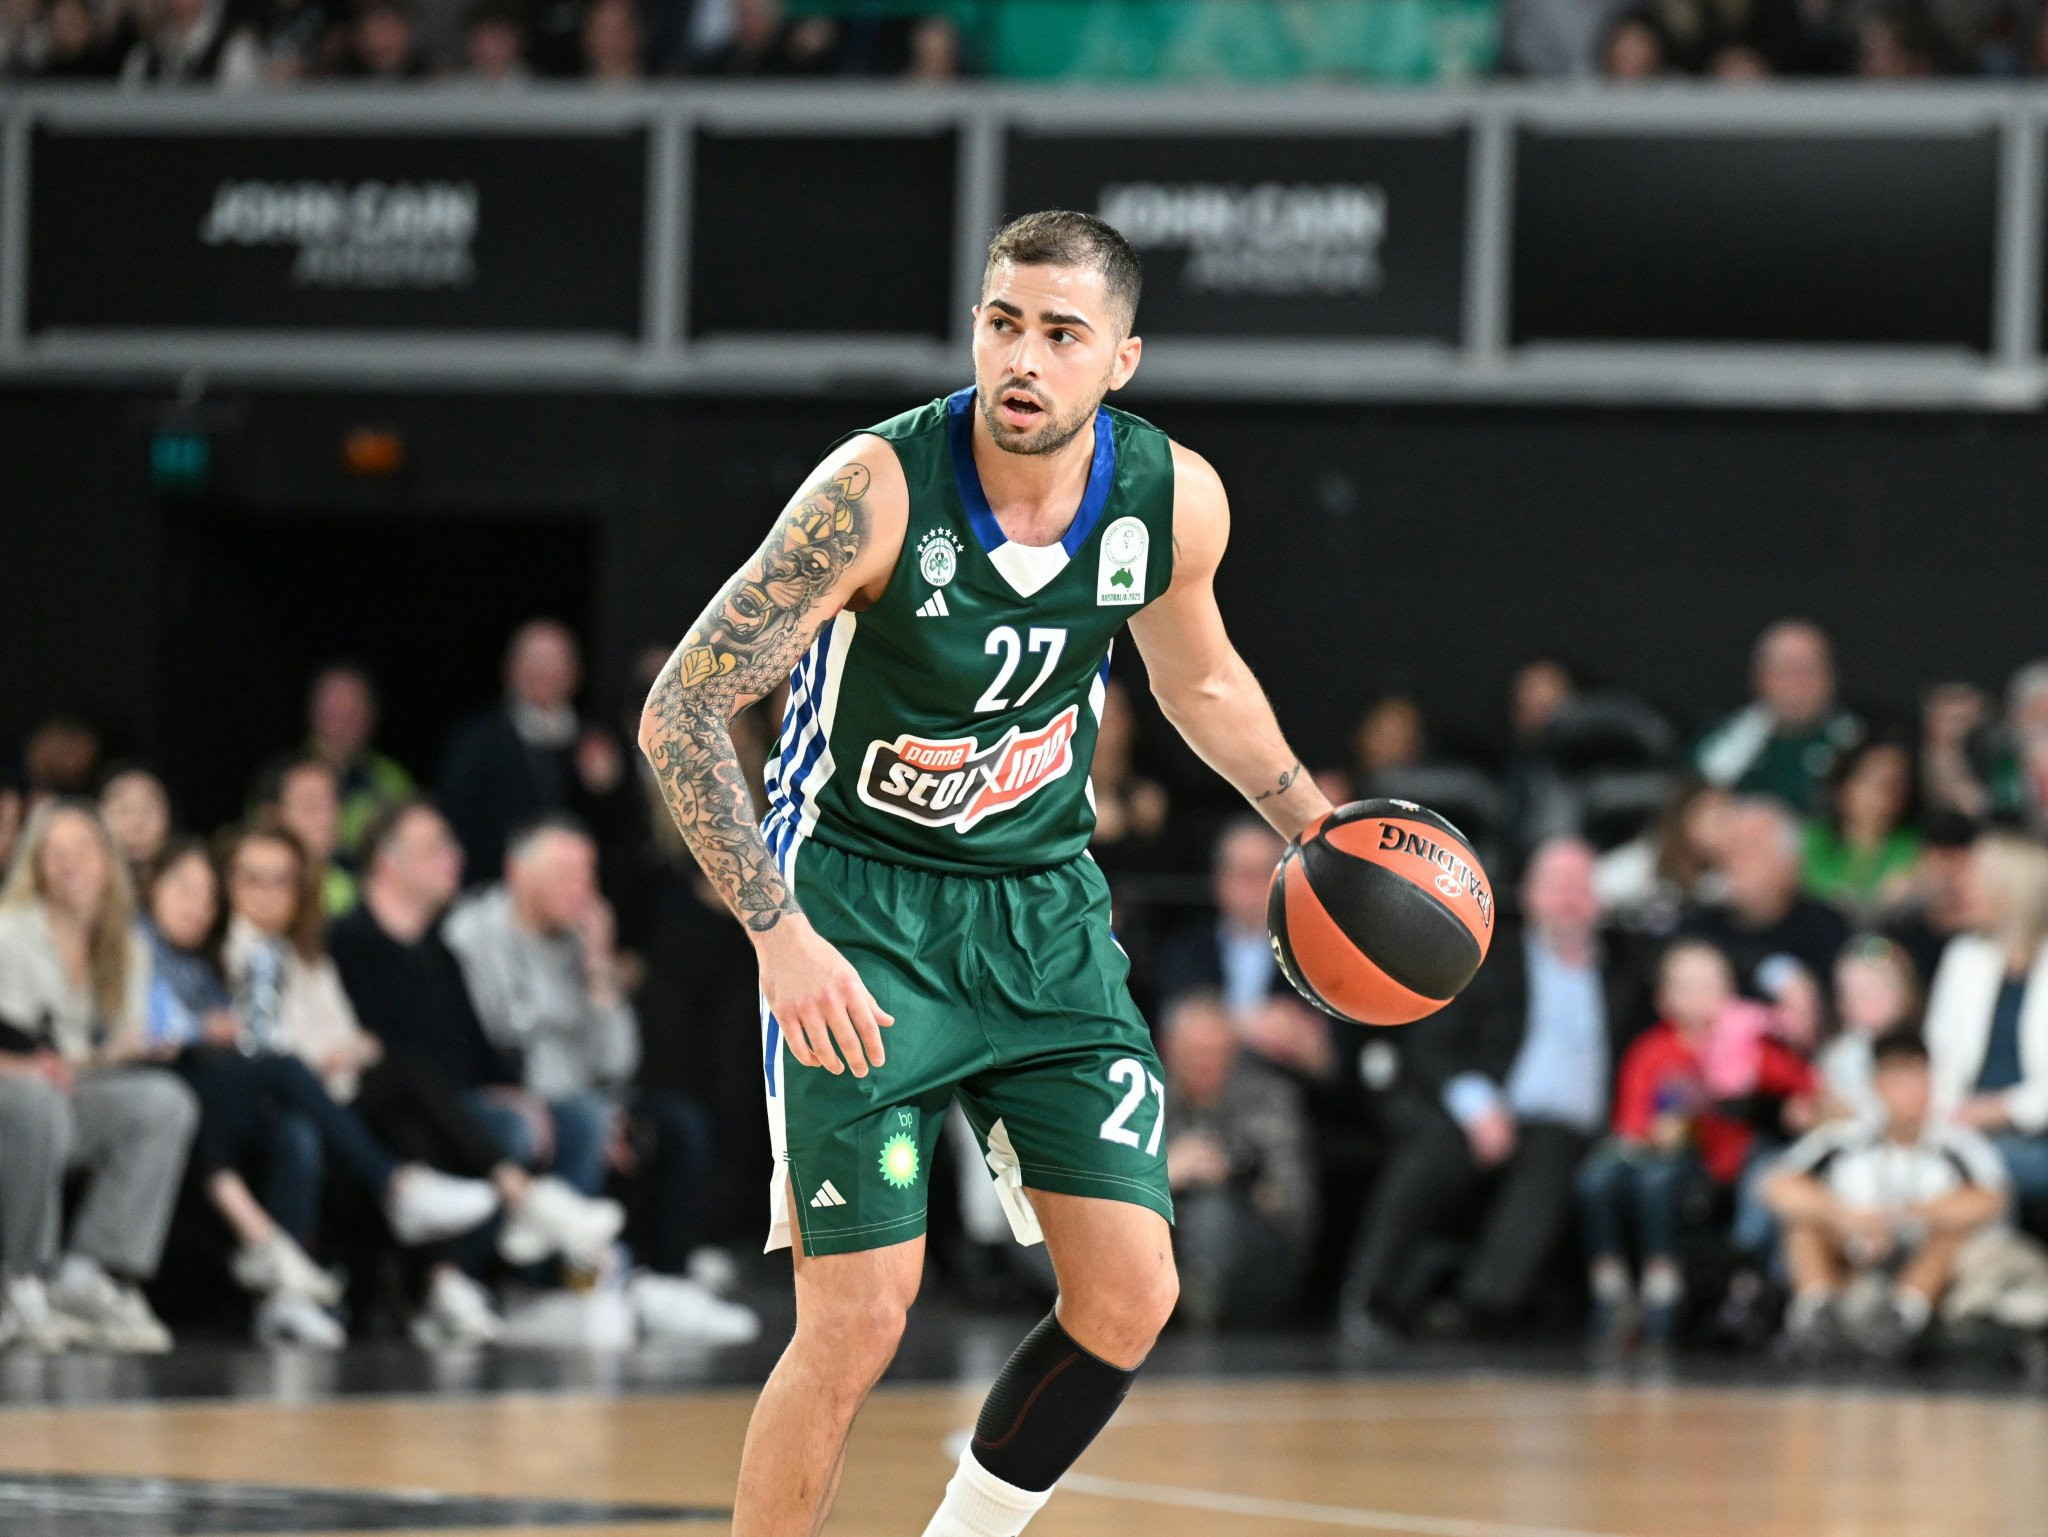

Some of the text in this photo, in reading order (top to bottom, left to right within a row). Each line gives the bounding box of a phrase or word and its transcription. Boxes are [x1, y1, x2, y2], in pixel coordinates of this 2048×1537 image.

[203, 183, 477, 243] JOHN CAIN
[1101, 592, 1141, 602] AUSTRALIA 2025
[973, 625, 1067, 713] 27
[904, 745, 965, 767] pame
[1378, 822, 1492, 928] SPALDING
[897, 1111, 913, 1129] bp
[1100, 1058, 1165, 1158] 27
